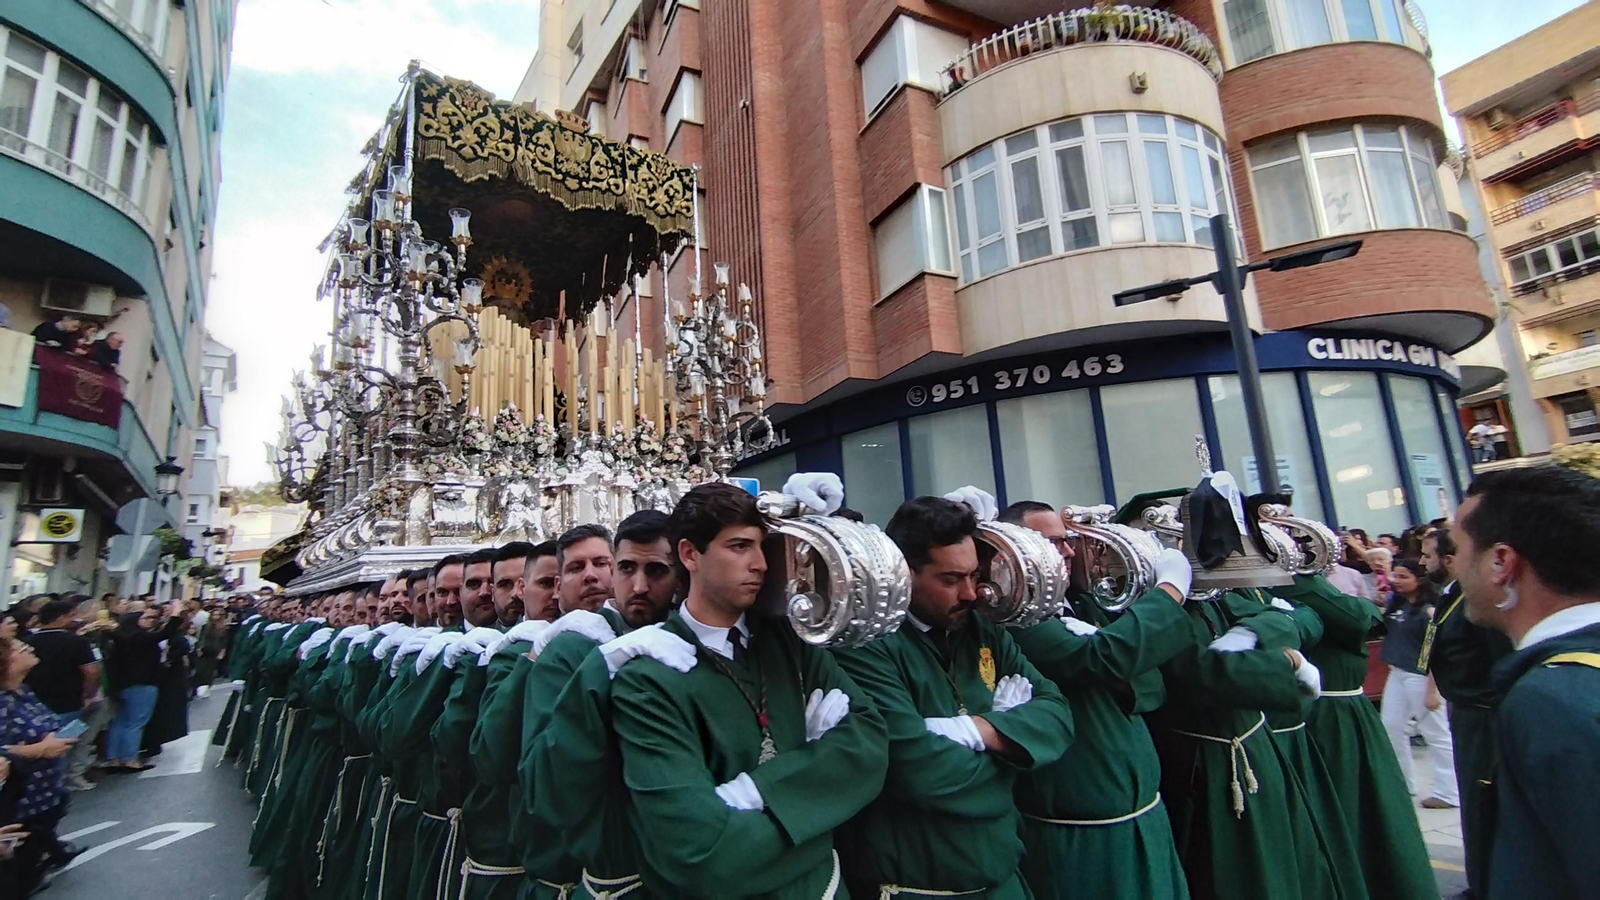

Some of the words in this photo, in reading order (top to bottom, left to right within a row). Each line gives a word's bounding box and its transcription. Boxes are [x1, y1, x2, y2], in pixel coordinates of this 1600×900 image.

[1307, 338, 1408, 363] CLINICA
[1407, 344, 1436, 367] GM
[931, 376, 980, 402] 951
[994, 365, 1050, 390] 370
[1061, 354, 1124, 379] 463
